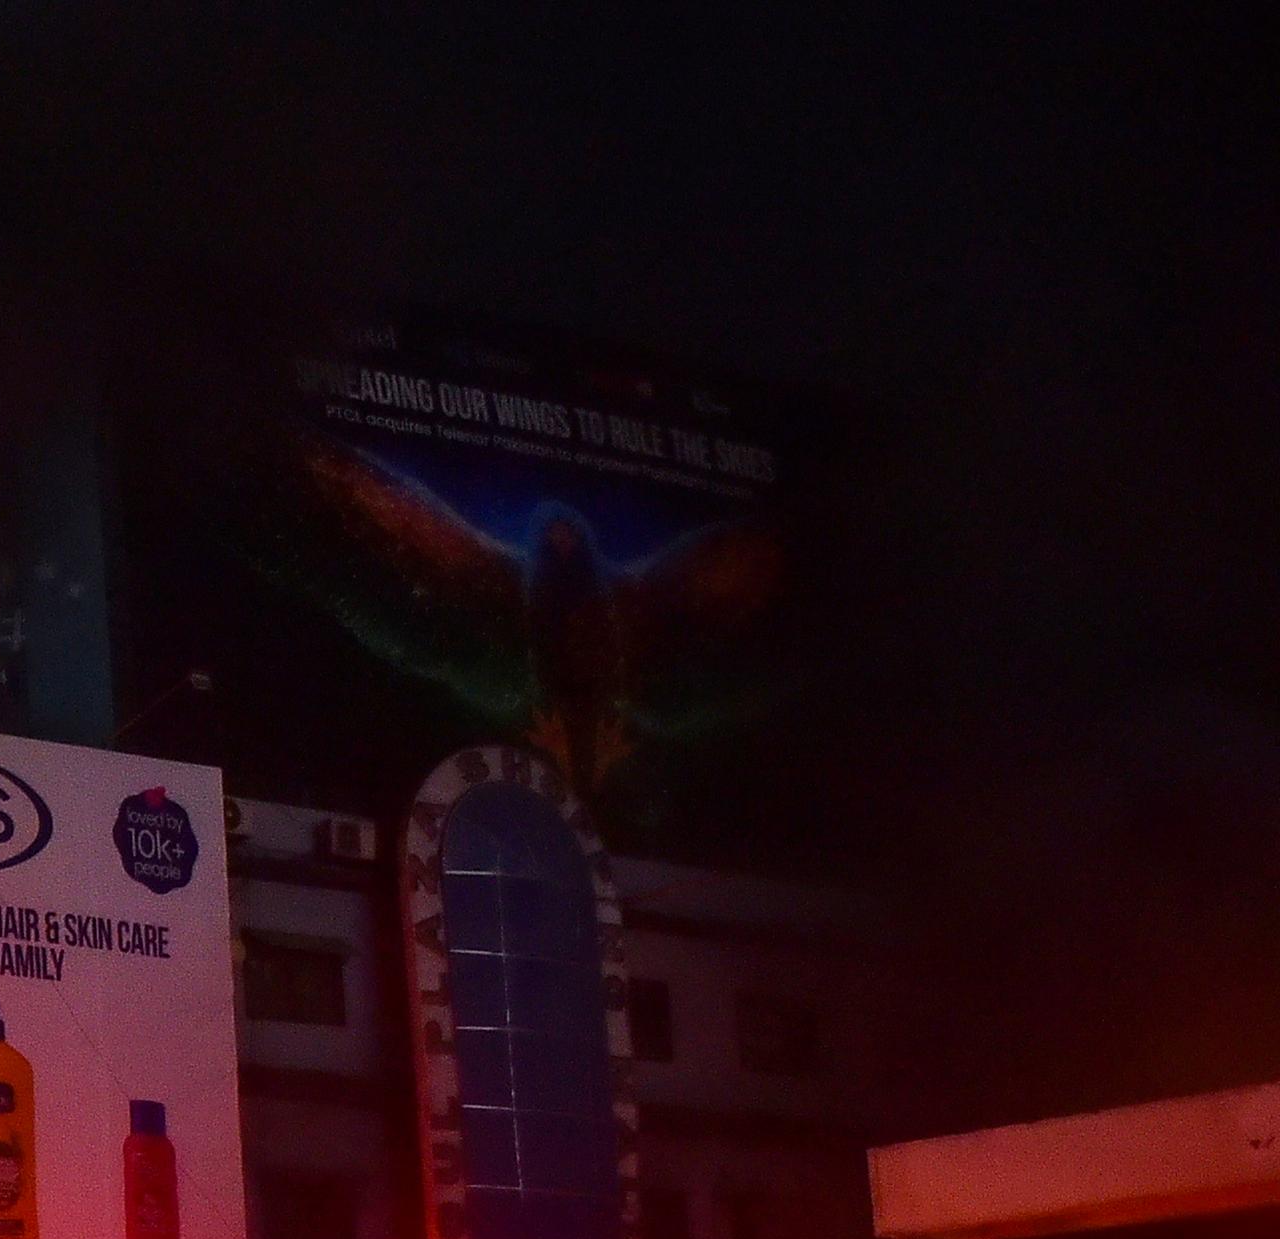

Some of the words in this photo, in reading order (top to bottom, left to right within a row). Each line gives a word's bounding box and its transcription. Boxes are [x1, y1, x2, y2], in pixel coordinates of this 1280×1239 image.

[325, 404, 364, 425] PTCL
[366, 413, 433, 437] acquires
[437, 423, 490, 448] Telenor
[439, 382, 489, 423] OUR
[492, 391, 572, 439] WINGS
[573, 407, 607, 446] TO
[609, 414, 666, 457] RULE
[669, 427, 713, 470] THE
[128, 827, 185, 861] 10k+
[134, 862, 181, 880] people
[46, 908, 59, 942] &
[65, 915, 112, 951] SKIN
[118, 920, 170, 959] CARE
[405, 798, 458, 1059] PLAZA
